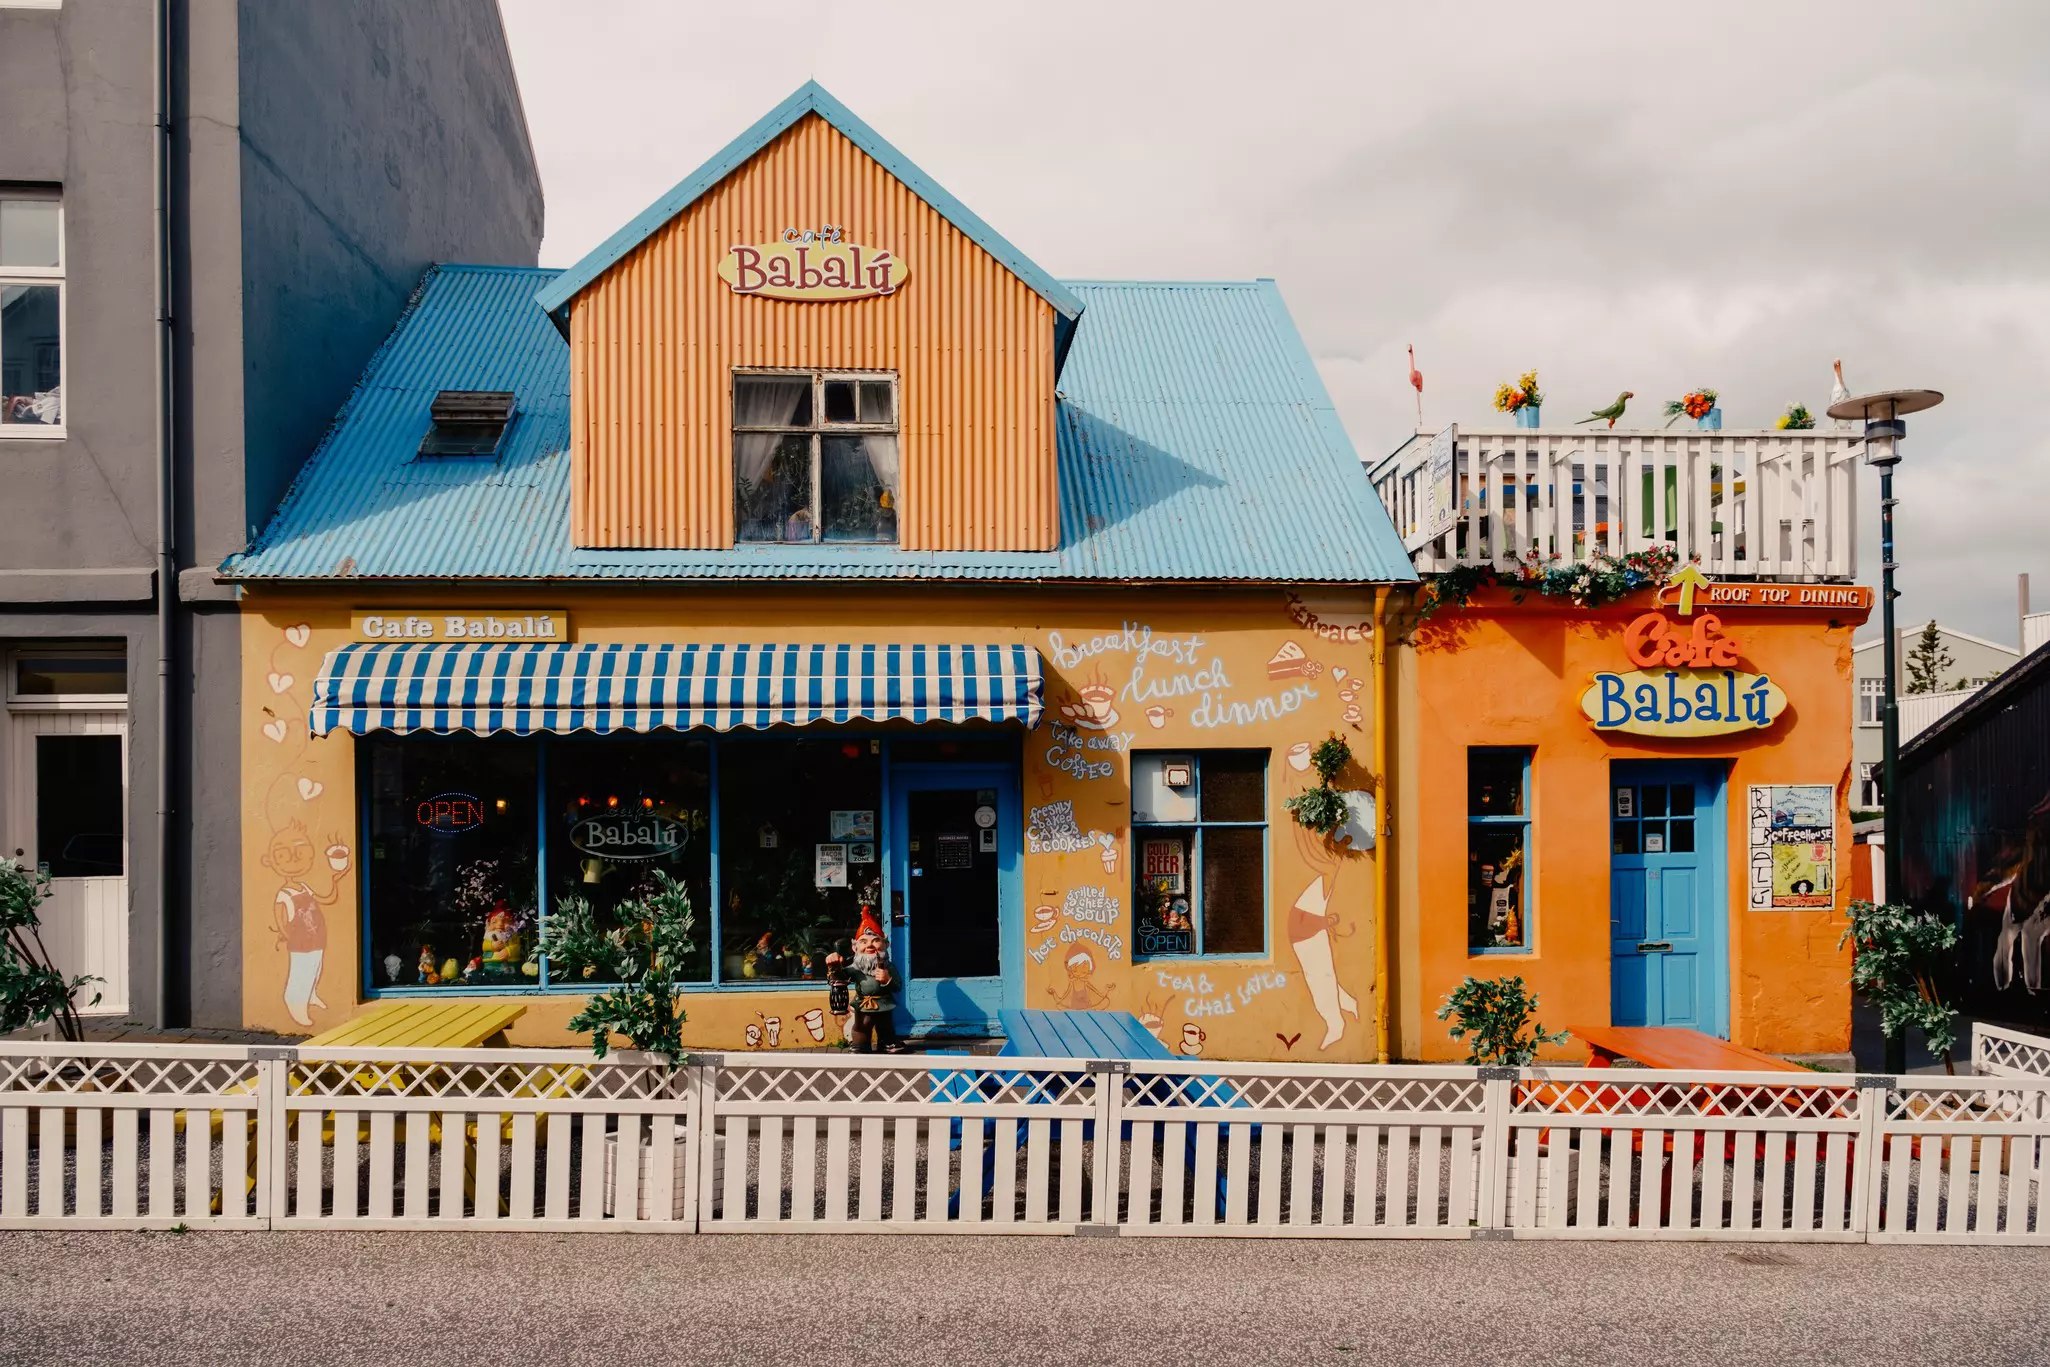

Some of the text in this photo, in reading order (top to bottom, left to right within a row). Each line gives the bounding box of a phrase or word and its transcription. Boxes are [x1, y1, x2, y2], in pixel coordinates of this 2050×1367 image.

[783, 224, 843, 249] café
[731, 246, 895, 293] Babalú
[1711, 587, 1859, 604] ROOF TOP DINING
[362, 615, 556, 638] Cafe Babalú
[1623, 611, 1742, 668] Cafe
[1120, 657, 1232, 703] lunch
[1191, 683, 1318, 729] dinner
[1595, 670, 1771, 727] Babalú
[1087, 731, 1136, 752] away
[417, 801, 484, 825] OPEN
[586, 820, 678, 848] Babalú
[1030, 840, 1041, 853] &
[1147, 843, 1170, 856] COLD
[1147, 855, 1179, 874] BEER
[1062, 902, 1074, 917] &
[1028, 937, 1057, 964] hot
[1145, 935, 1187, 951] OPEN
[1198, 973, 1214, 994] &
